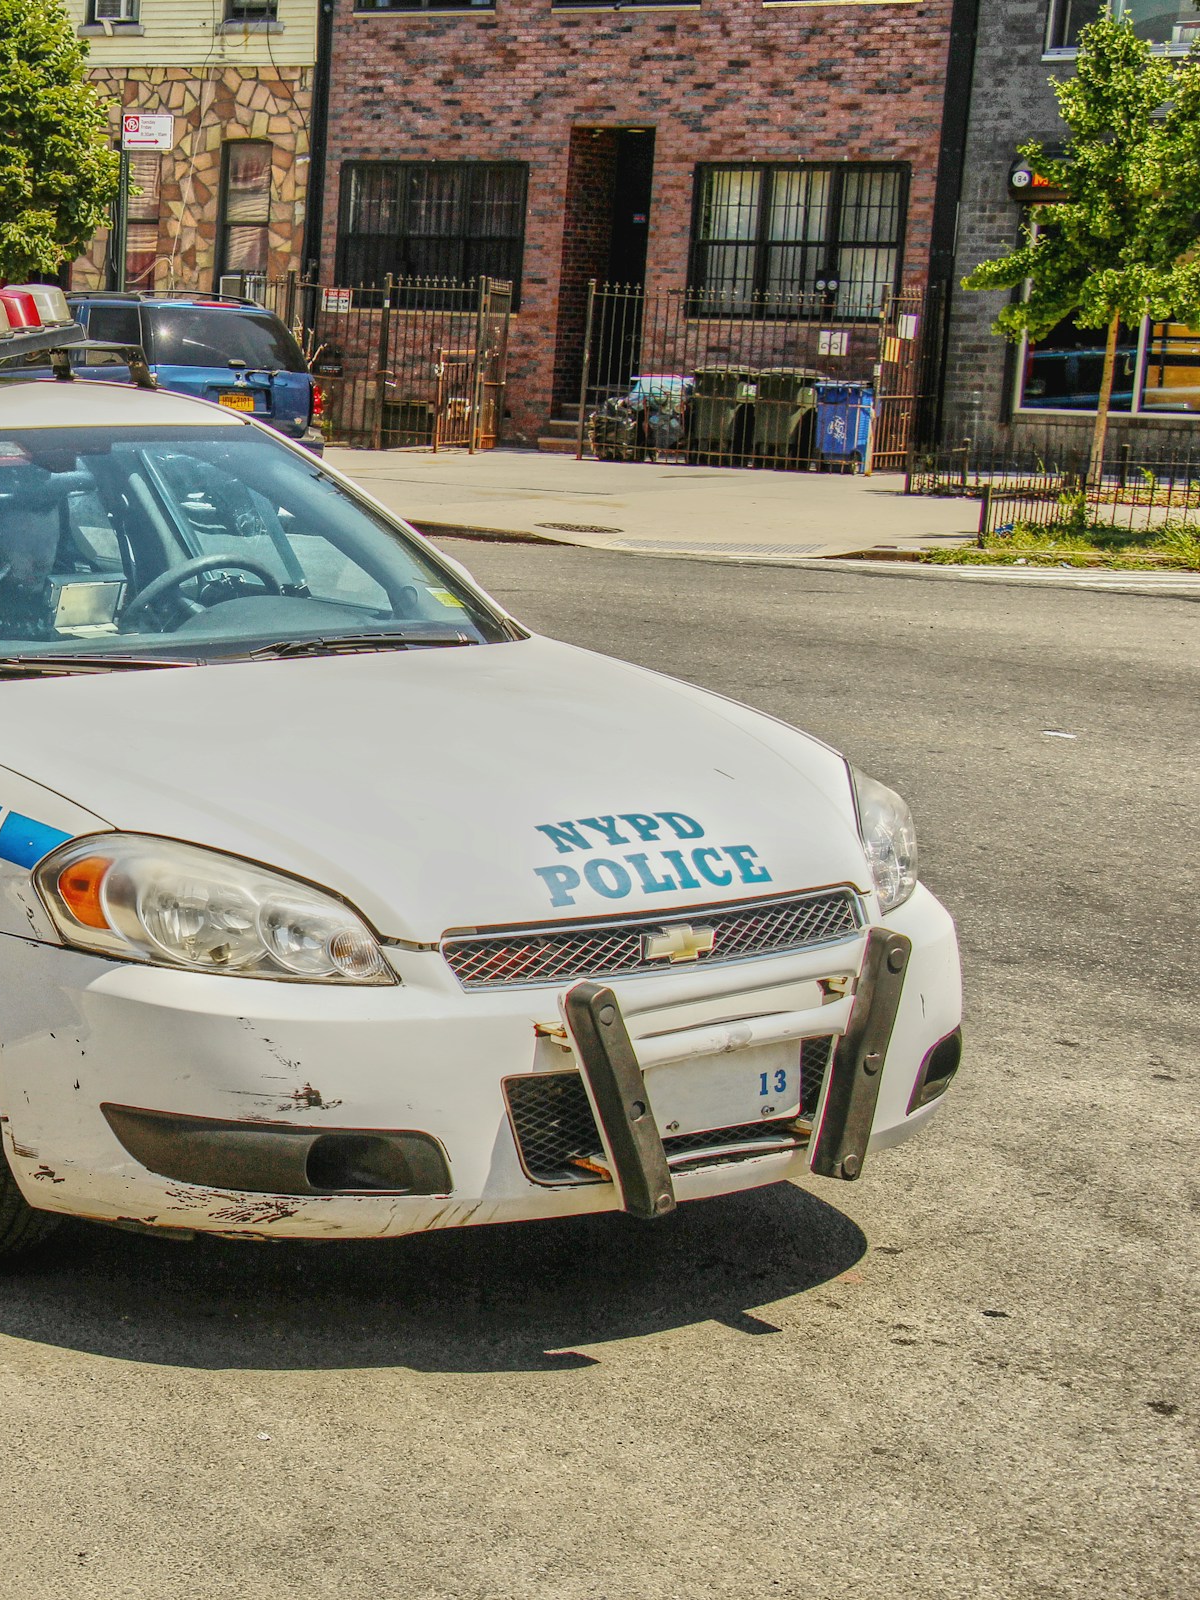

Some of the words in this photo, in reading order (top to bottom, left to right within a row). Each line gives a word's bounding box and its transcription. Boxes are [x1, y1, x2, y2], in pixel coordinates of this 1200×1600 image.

[534, 812, 705, 854] NYPD
[533, 845, 773, 908] POLICE
[759, 1069, 786, 1096] 13
